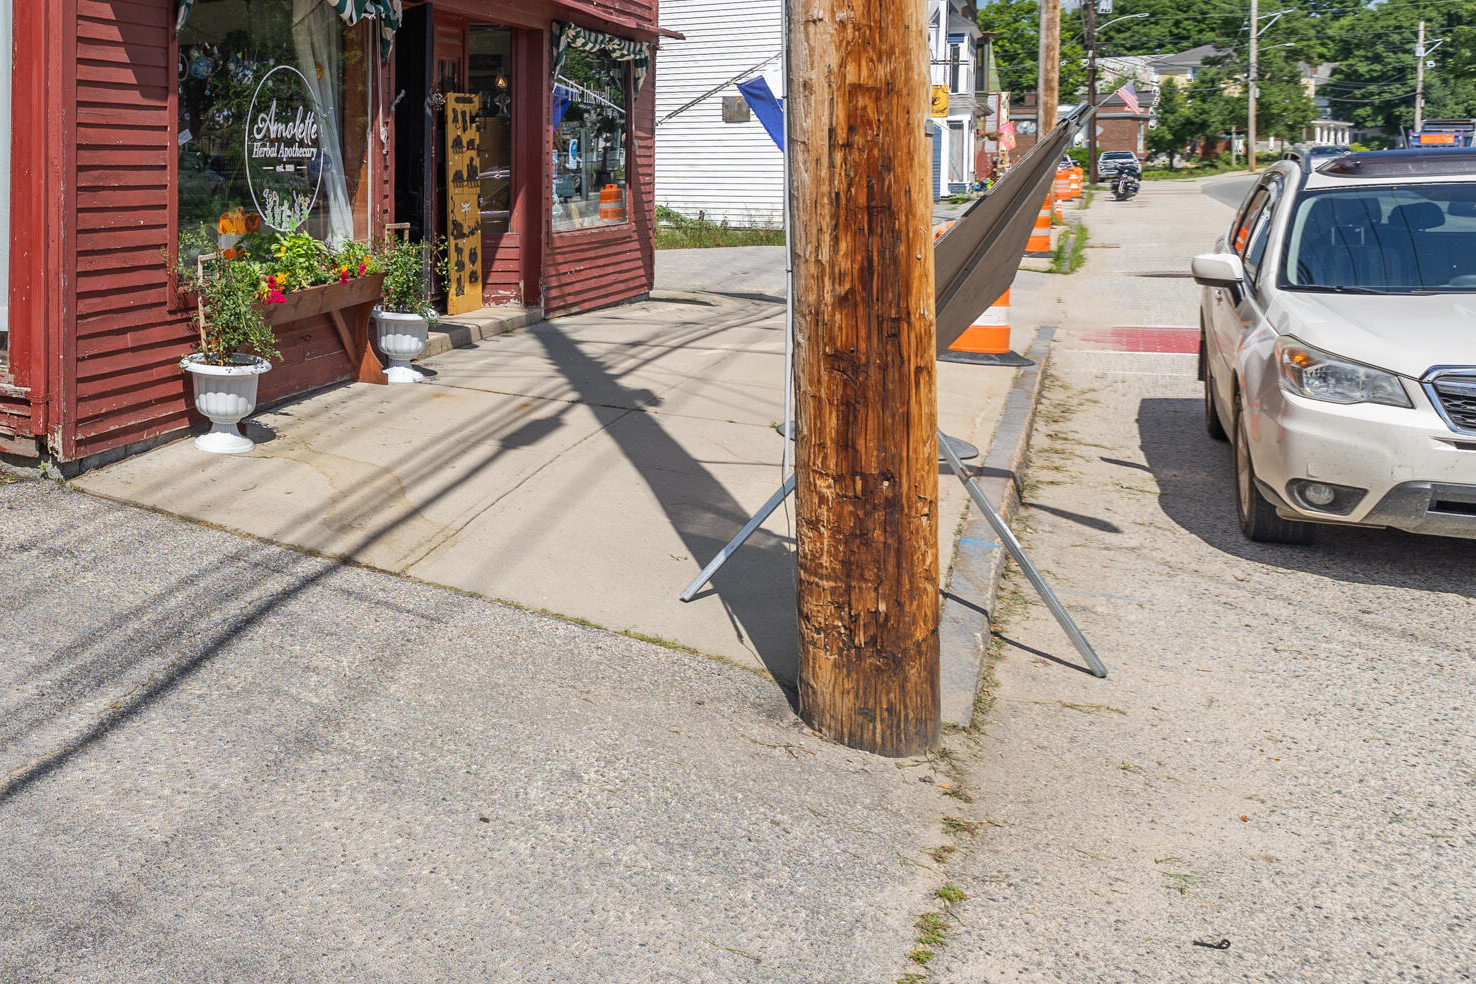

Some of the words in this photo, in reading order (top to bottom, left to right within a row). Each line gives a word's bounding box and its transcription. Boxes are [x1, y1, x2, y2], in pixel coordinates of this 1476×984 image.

[253, 98, 318, 146] Amolette
[252, 142, 278, 158] Herbal
[278, 142, 317, 161] Apothecary
